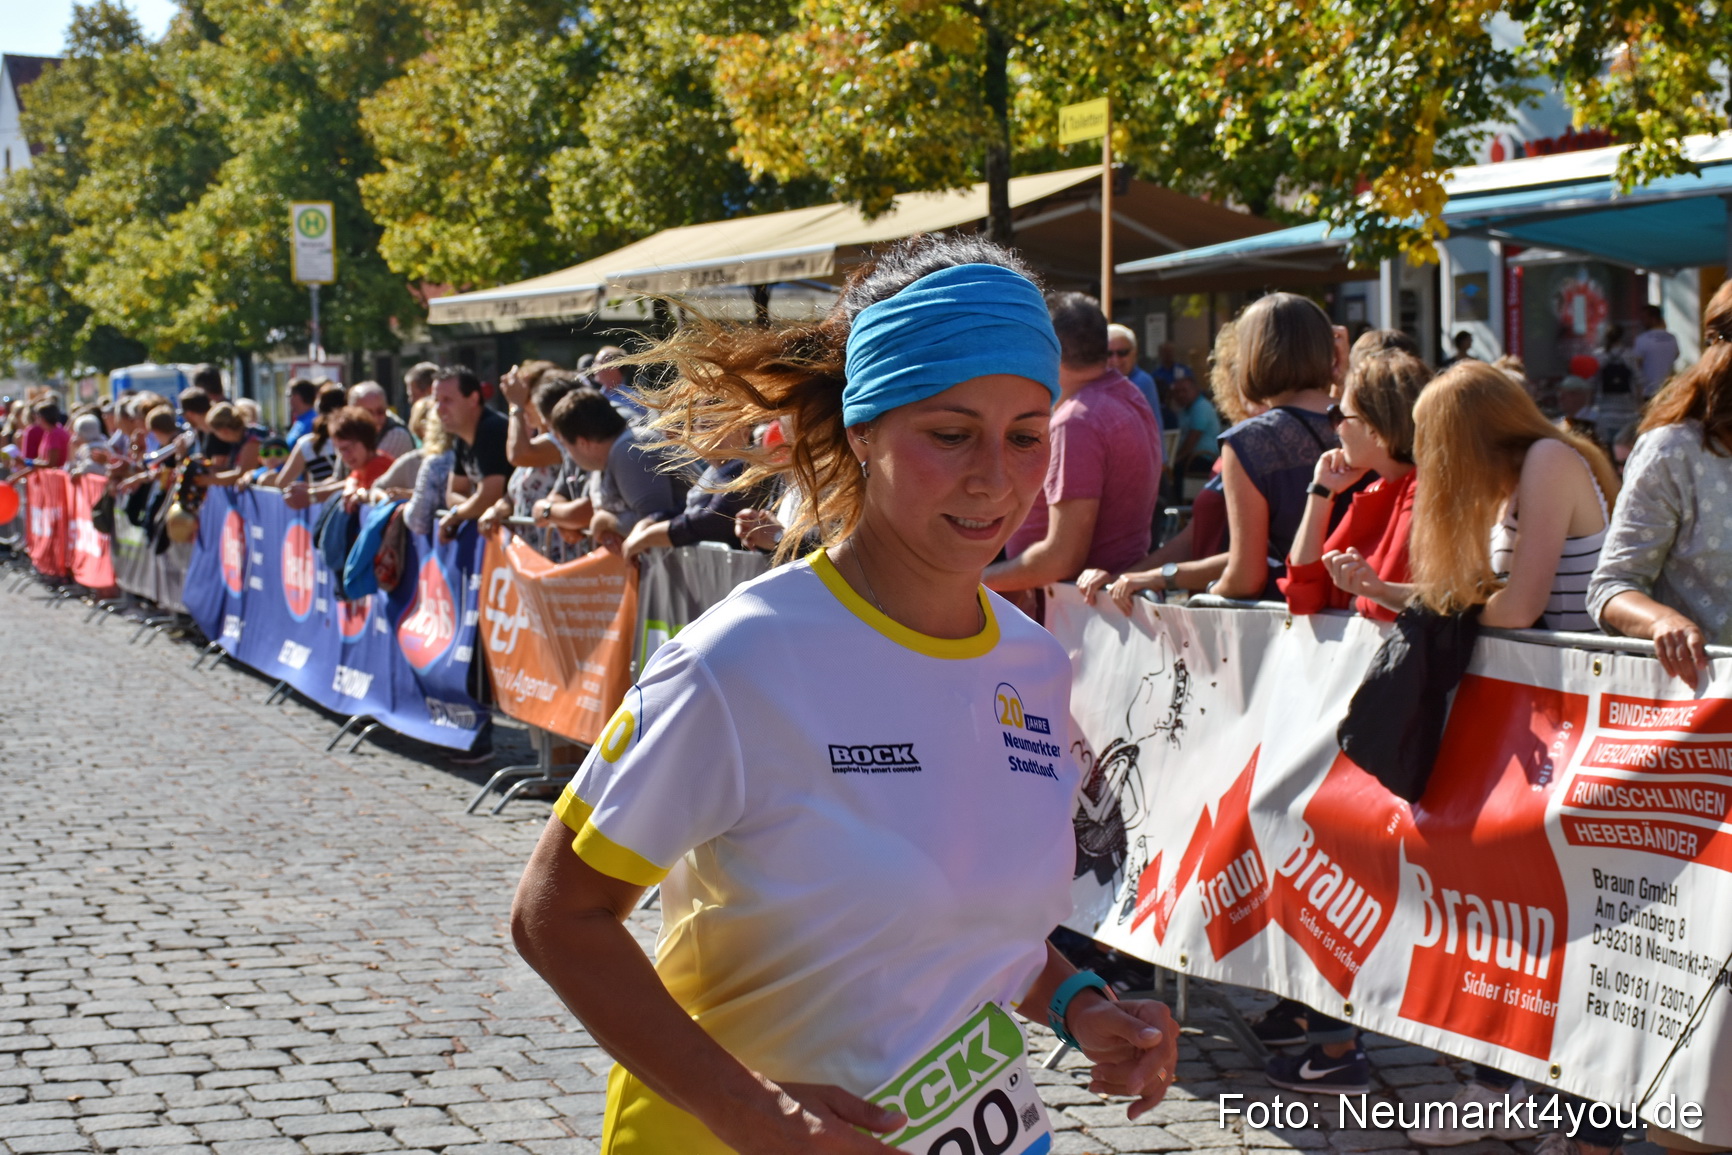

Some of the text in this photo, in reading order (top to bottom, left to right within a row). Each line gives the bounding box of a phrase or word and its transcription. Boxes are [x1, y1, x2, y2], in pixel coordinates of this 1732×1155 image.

[997, 693, 1049, 733] 20 JAHRE
[828, 743, 919, 765] BOCK
[1003, 731, 1061, 757] Neumarkter
[1547, 720, 1573, 758] 1929
[1008, 755, 1059, 781] Stadtlauf
[1572, 781, 1725, 816] RUNDSCHLINGEN
[1574, 821, 1698, 857] HEBEBÄNDER
[1197, 849, 1263, 928] Braun
[1276, 820, 1383, 948] Braun
[1592, 868, 1678, 907] Braun GmbH
[1402, 848, 1555, 980] Braun
[1595, 896, 1686, 942] Am Grünberg 8
[1299, 907, 1361, 975] Sicher ist sicher
[1593, 923, 1642, 957] D-92318
[1461, 970, 1559, 1018] Sicher ist sicher
[1590, 964, 1611, 990] Tel.
[1615, 971, 1650, 1001] 09181
[1660, 985, 1693, 1017] 2307-0
[1587, 992, 1610, 1018] Fax
[1612, 1000, 1647, 1030] 09181
[1009, 1073, 1019, 1087] D
